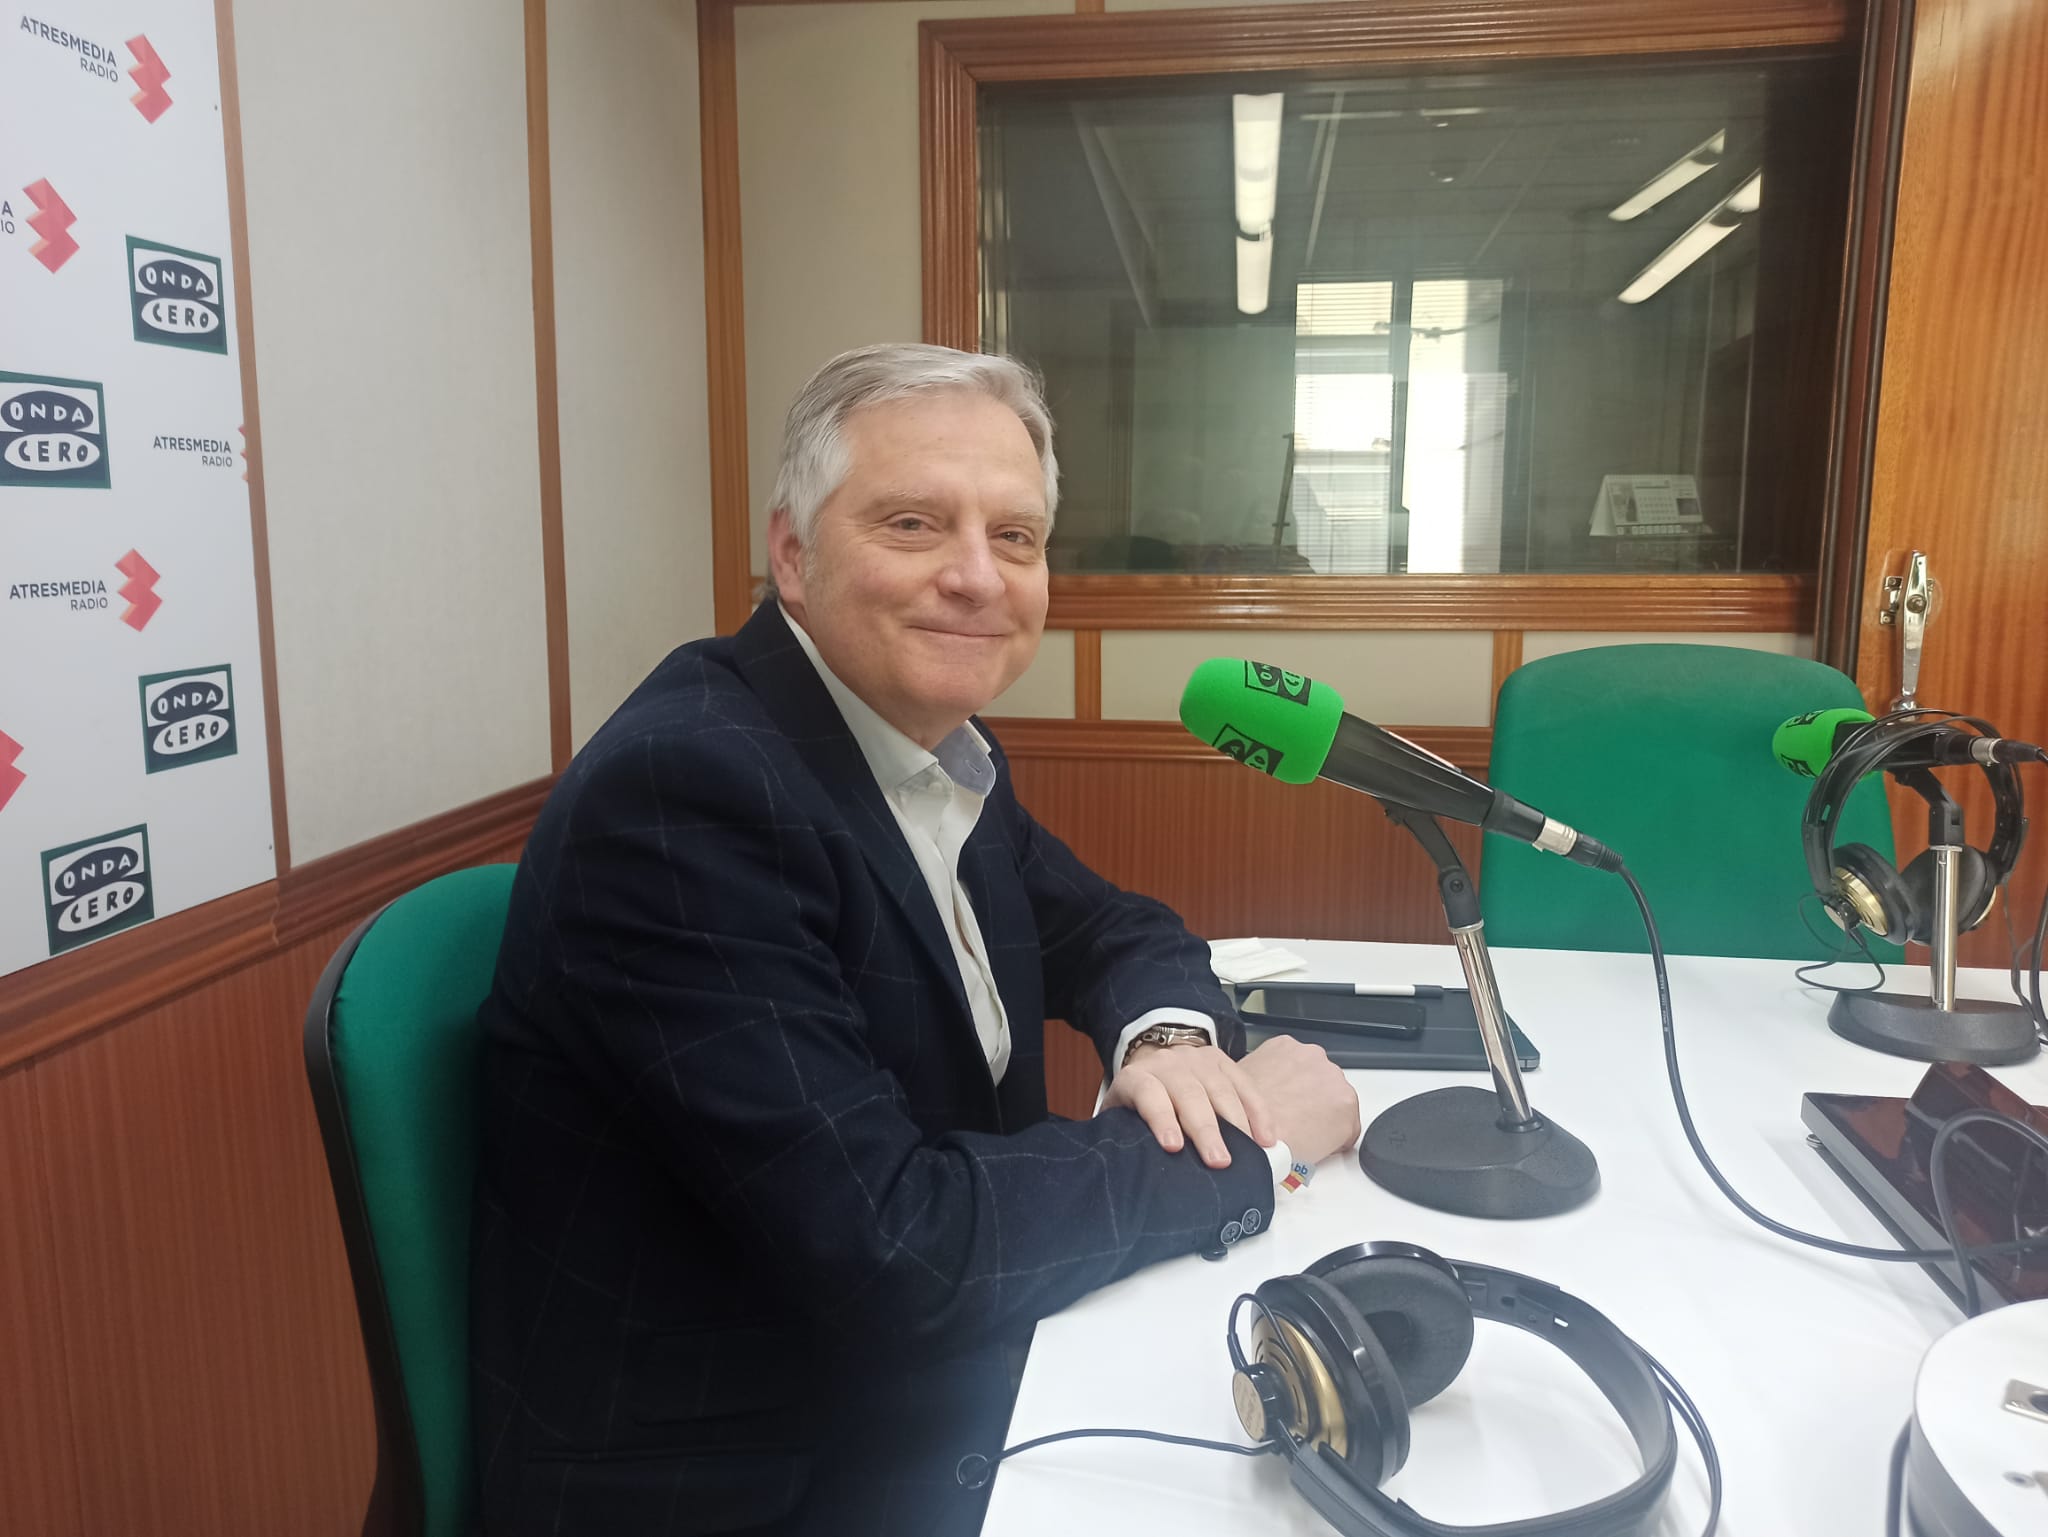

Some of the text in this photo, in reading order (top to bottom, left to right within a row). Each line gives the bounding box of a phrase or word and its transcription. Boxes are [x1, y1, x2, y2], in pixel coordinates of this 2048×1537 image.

[20, 15, 117, 67] ATRESMEDIA
[80, 57, 119, 83] RADIO
[145, 266, 207, 293] ONDA
[152, 303, 209, 328] CERO
[10, 401, 85, 424] ONDA
[18, 440, 89, 462] CERO
[153, 435, 232, 454] ATRESMEDIA
[202, 455, 233, 468] RADIO
[9, 580, 107, 600] ATRESMEDIA
[70, 597, 109, 611] RADIO
[157, 689, 217, 715] ONDA
[164, 720, 220, 748] CERO
[63, 853, 131, 890] ONDA
[70, 886, 134, 925] CERO
